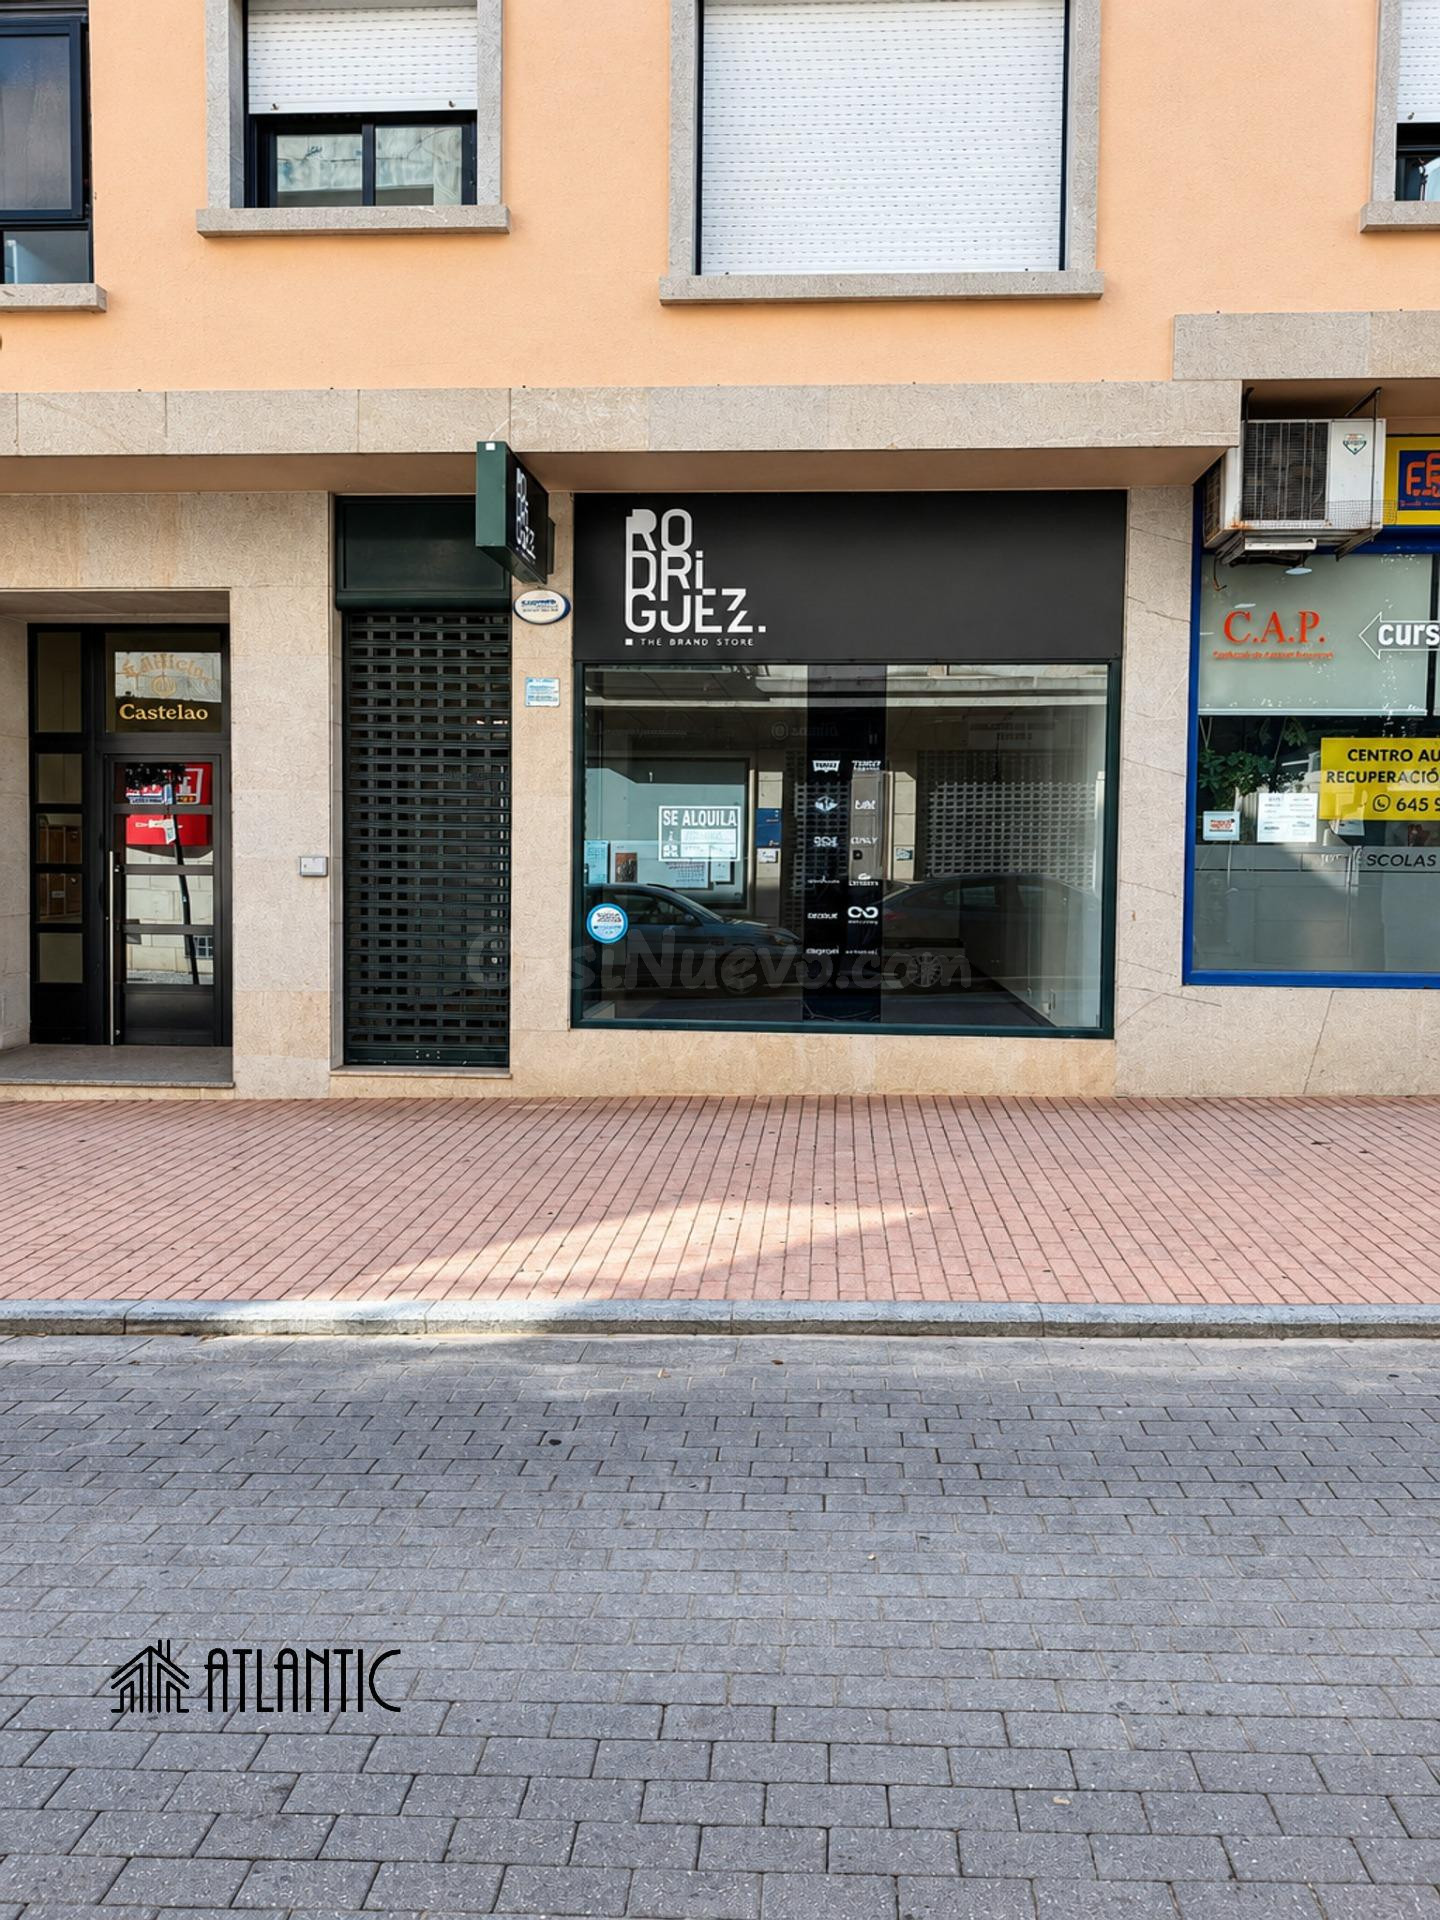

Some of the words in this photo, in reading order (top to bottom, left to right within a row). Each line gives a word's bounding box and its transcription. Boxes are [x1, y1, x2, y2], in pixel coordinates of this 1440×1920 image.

[1223, 610, 1326, 644] C.A.P.
[641, 638, 662, 646] THE
[669, 638, 709, 646] BRAND
[716, 638, 754, 646] STORE
[119, 703, 208, 720] Castelao
[1347, 749, 1413, 762] CENTRO
[1326, 767, 1439, 784] RECUPERACIÓ
[1396, 797, 1429, 812] 645
[663, 810, 679, 826] SE
[682, 810, 737, 827] ALQUILA
